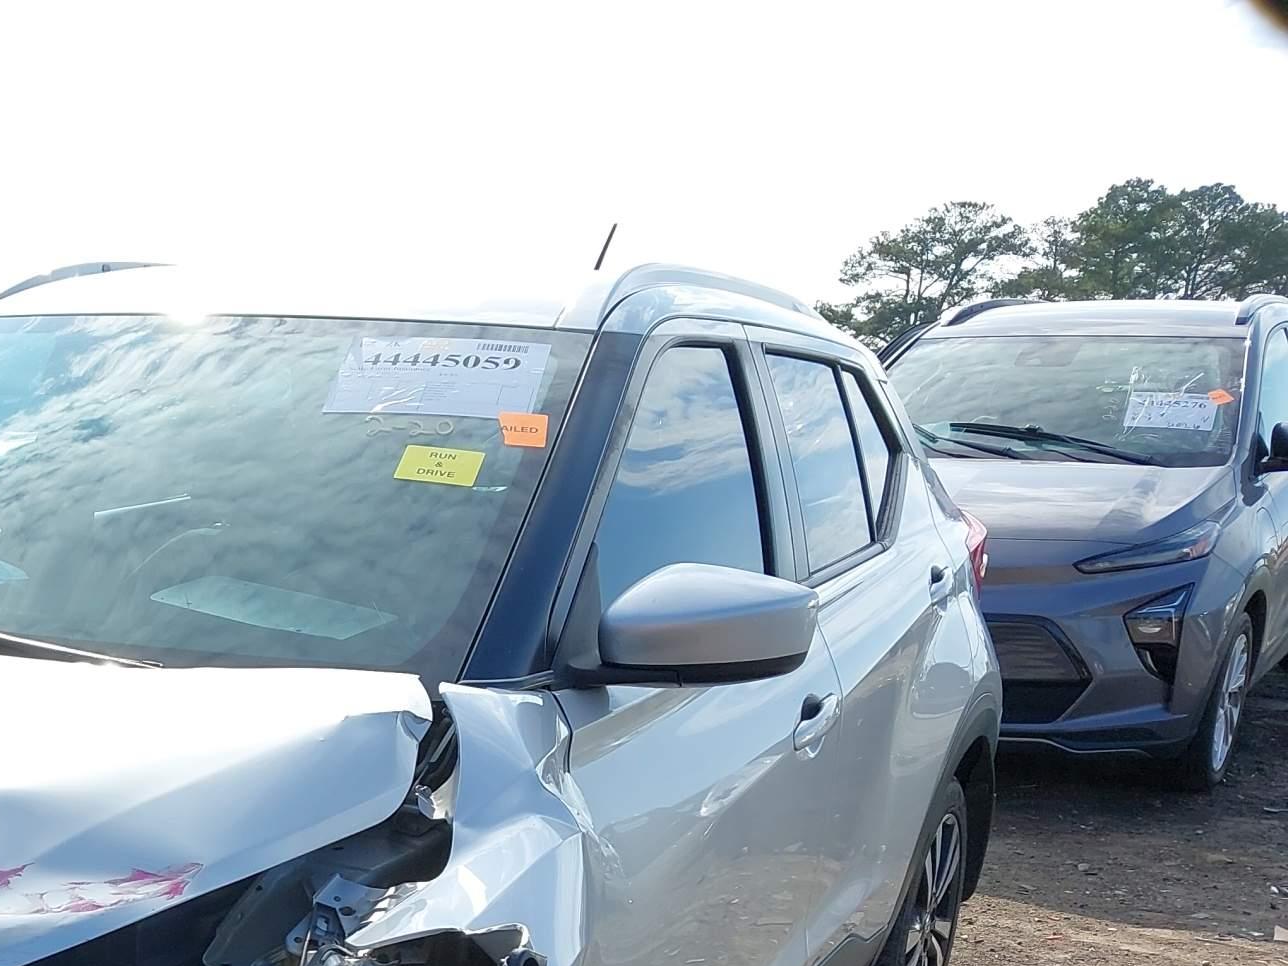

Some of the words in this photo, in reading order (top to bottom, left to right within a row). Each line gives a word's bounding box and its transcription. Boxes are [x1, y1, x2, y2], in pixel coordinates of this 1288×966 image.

[363, 351, 522, 371] 44445059
[428, 451, 457, 461] RUN
[416, 467, 456, 479] DRIVE
